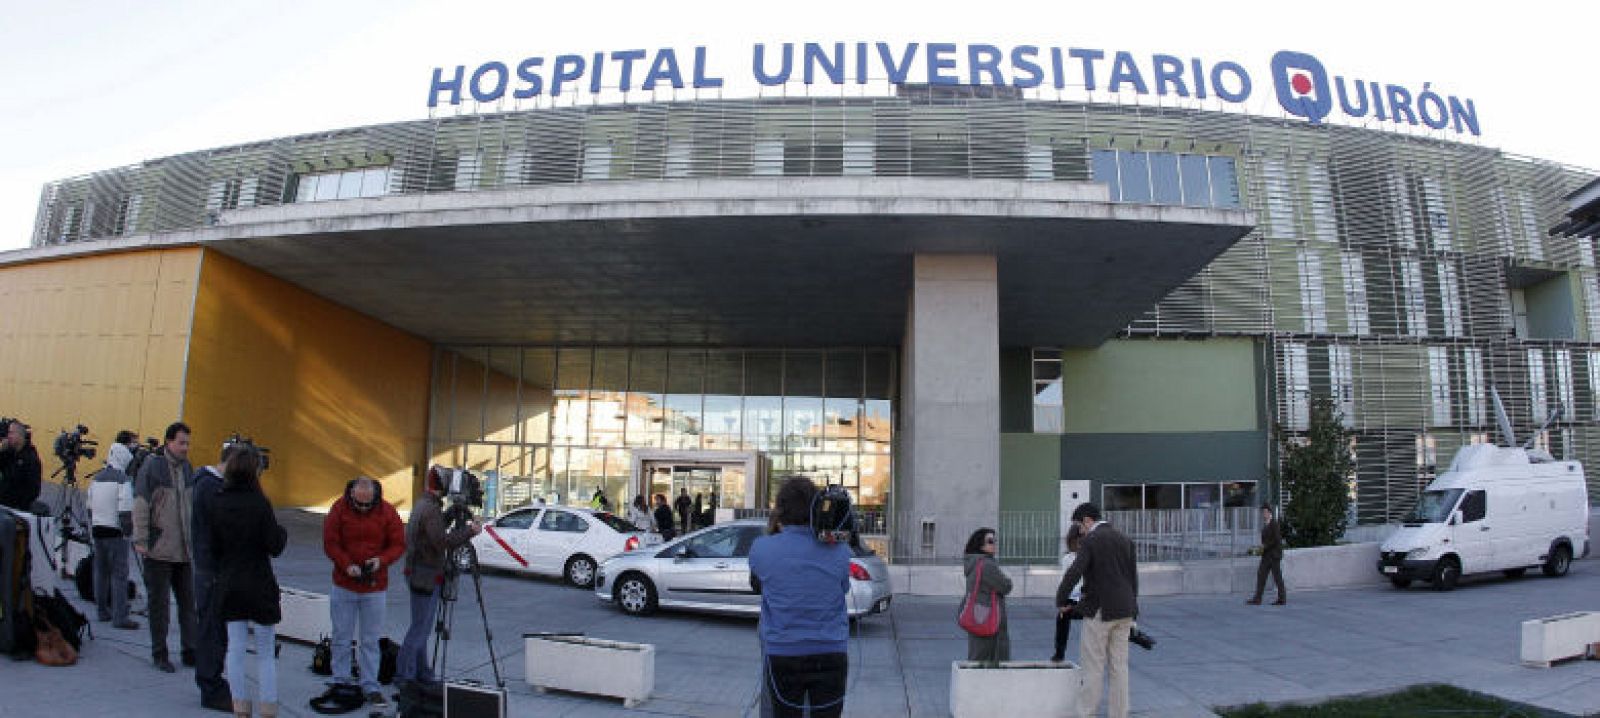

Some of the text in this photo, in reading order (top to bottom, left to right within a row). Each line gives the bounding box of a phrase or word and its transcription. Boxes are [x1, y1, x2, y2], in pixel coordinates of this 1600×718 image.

[428, 42, 1481, 136] HOSPITAL UNIVERSITARIO QUIRÓN
